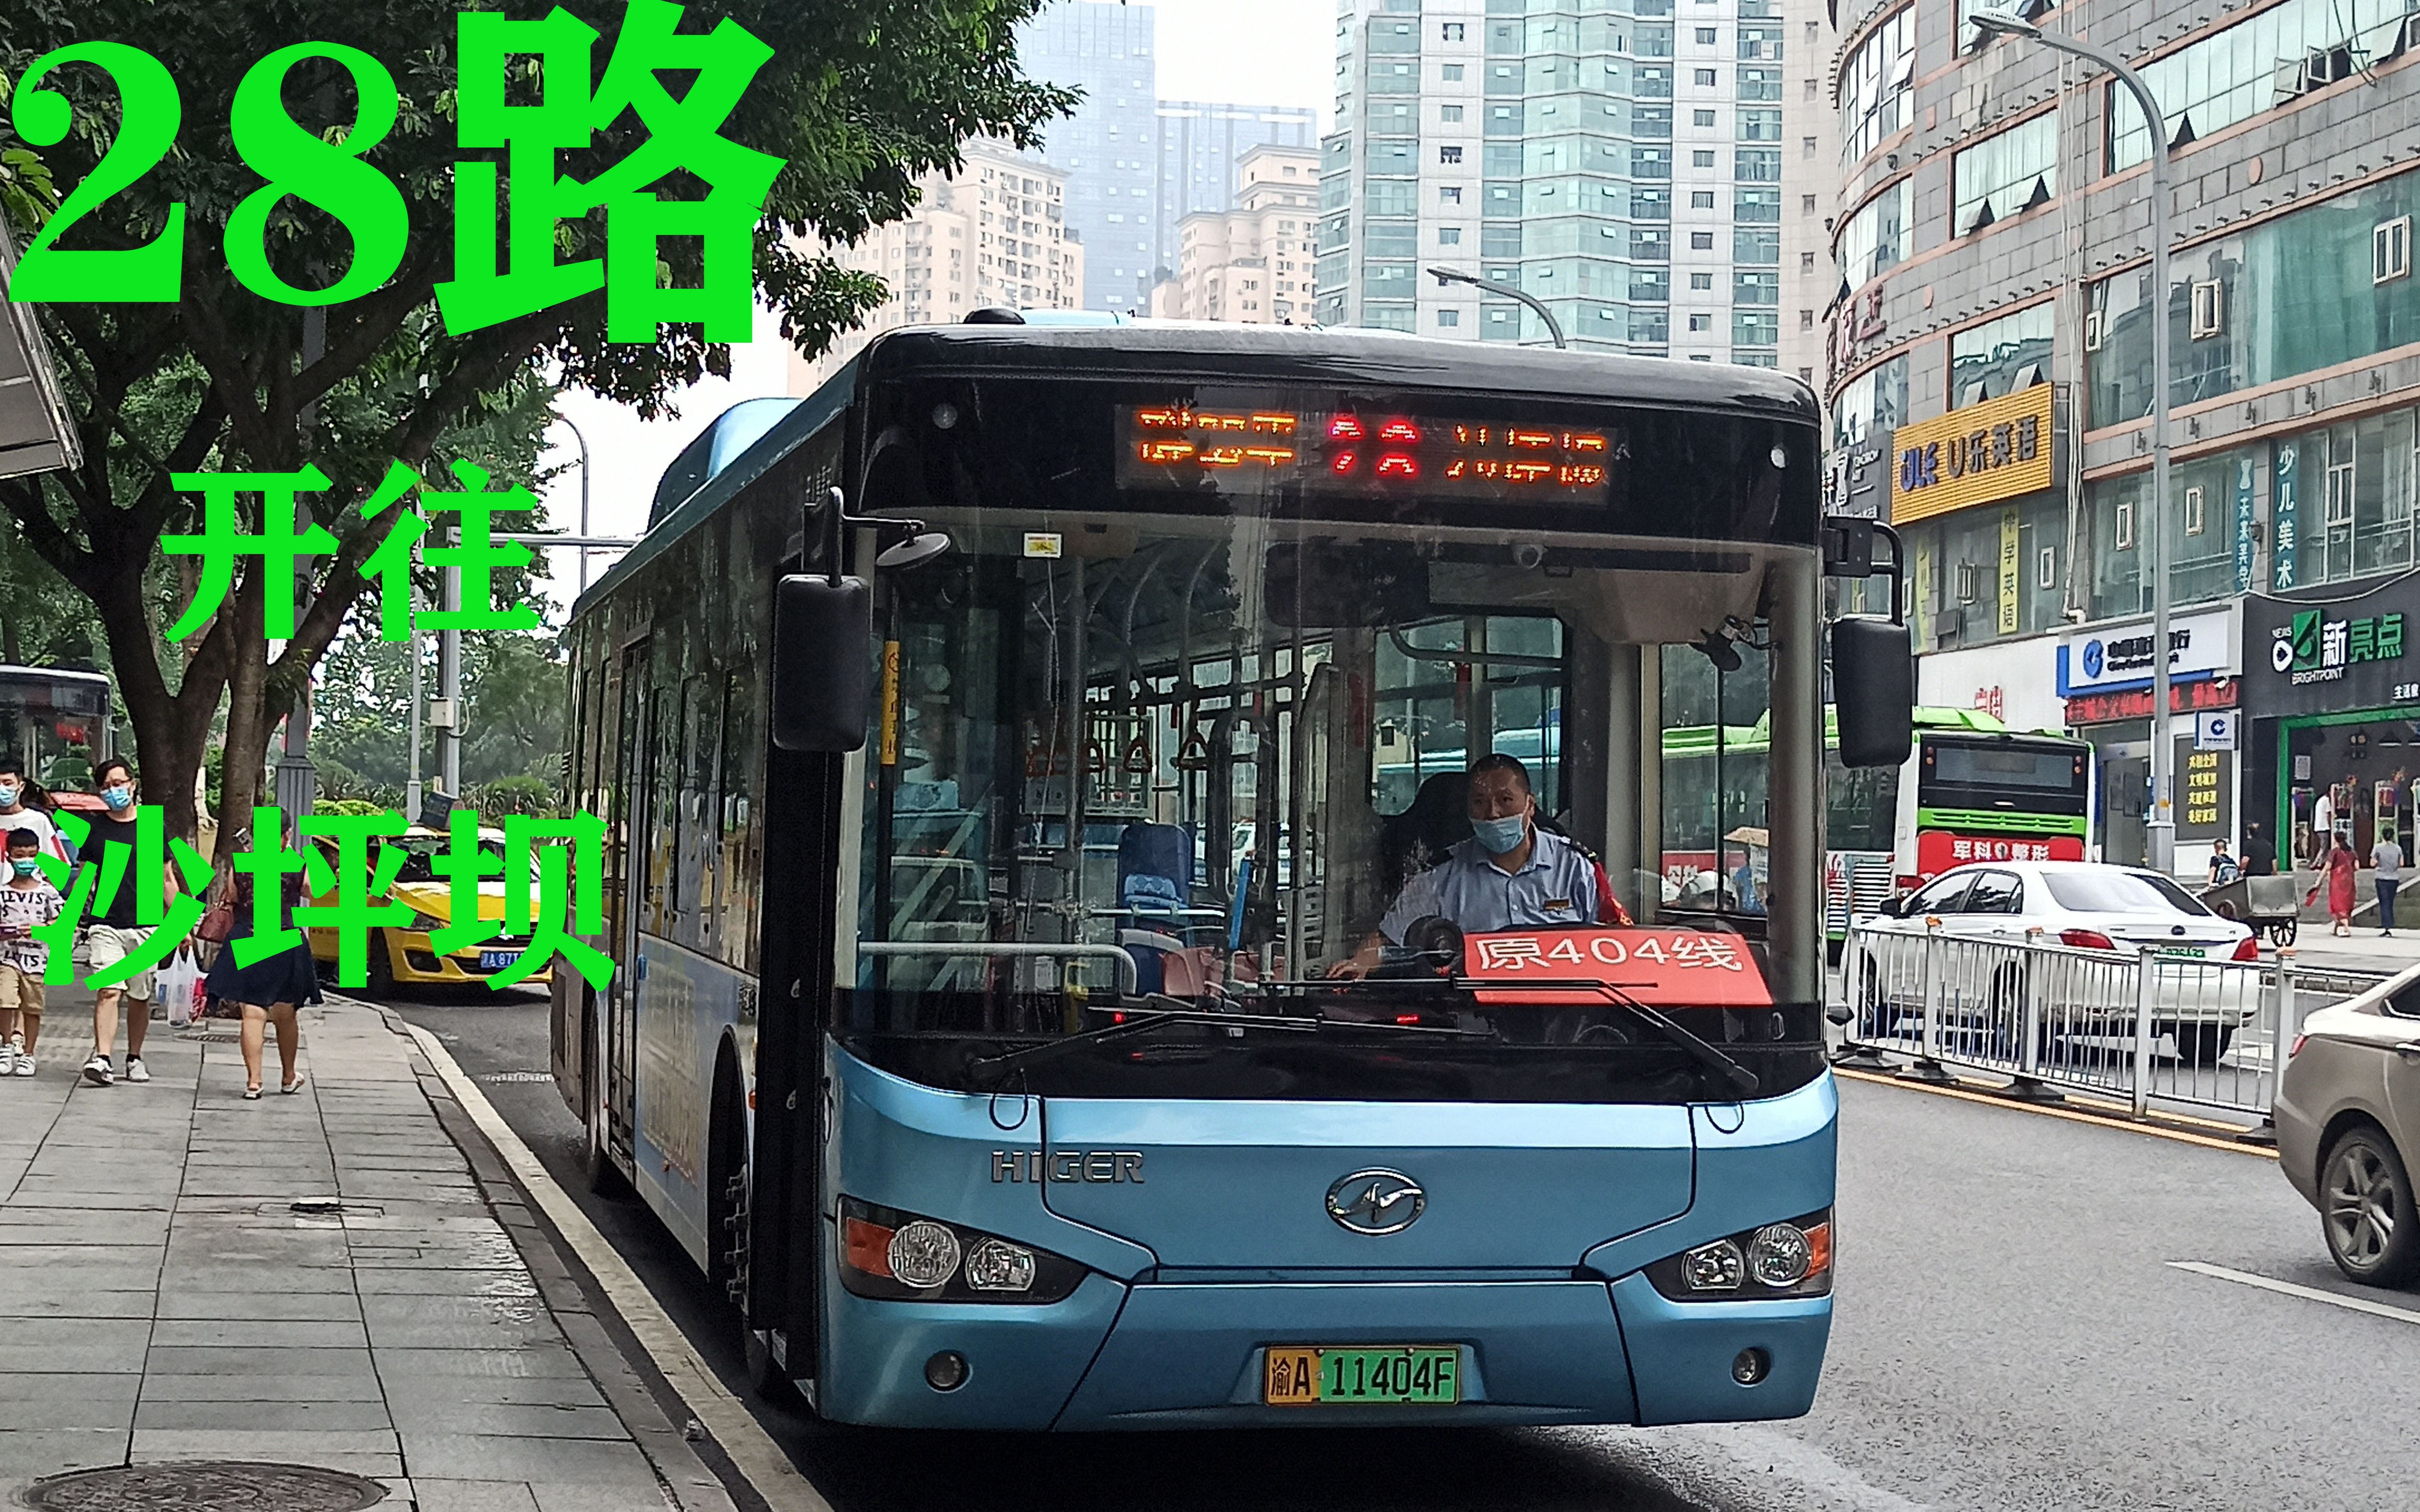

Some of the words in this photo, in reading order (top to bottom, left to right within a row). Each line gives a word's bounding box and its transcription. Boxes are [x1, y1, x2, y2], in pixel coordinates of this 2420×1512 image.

[2276, 445, 2295, 589] 少儿美术
[1476, 936, 1743, 972] 原404线
[991, 1150, 1145, 1184] HIGER
